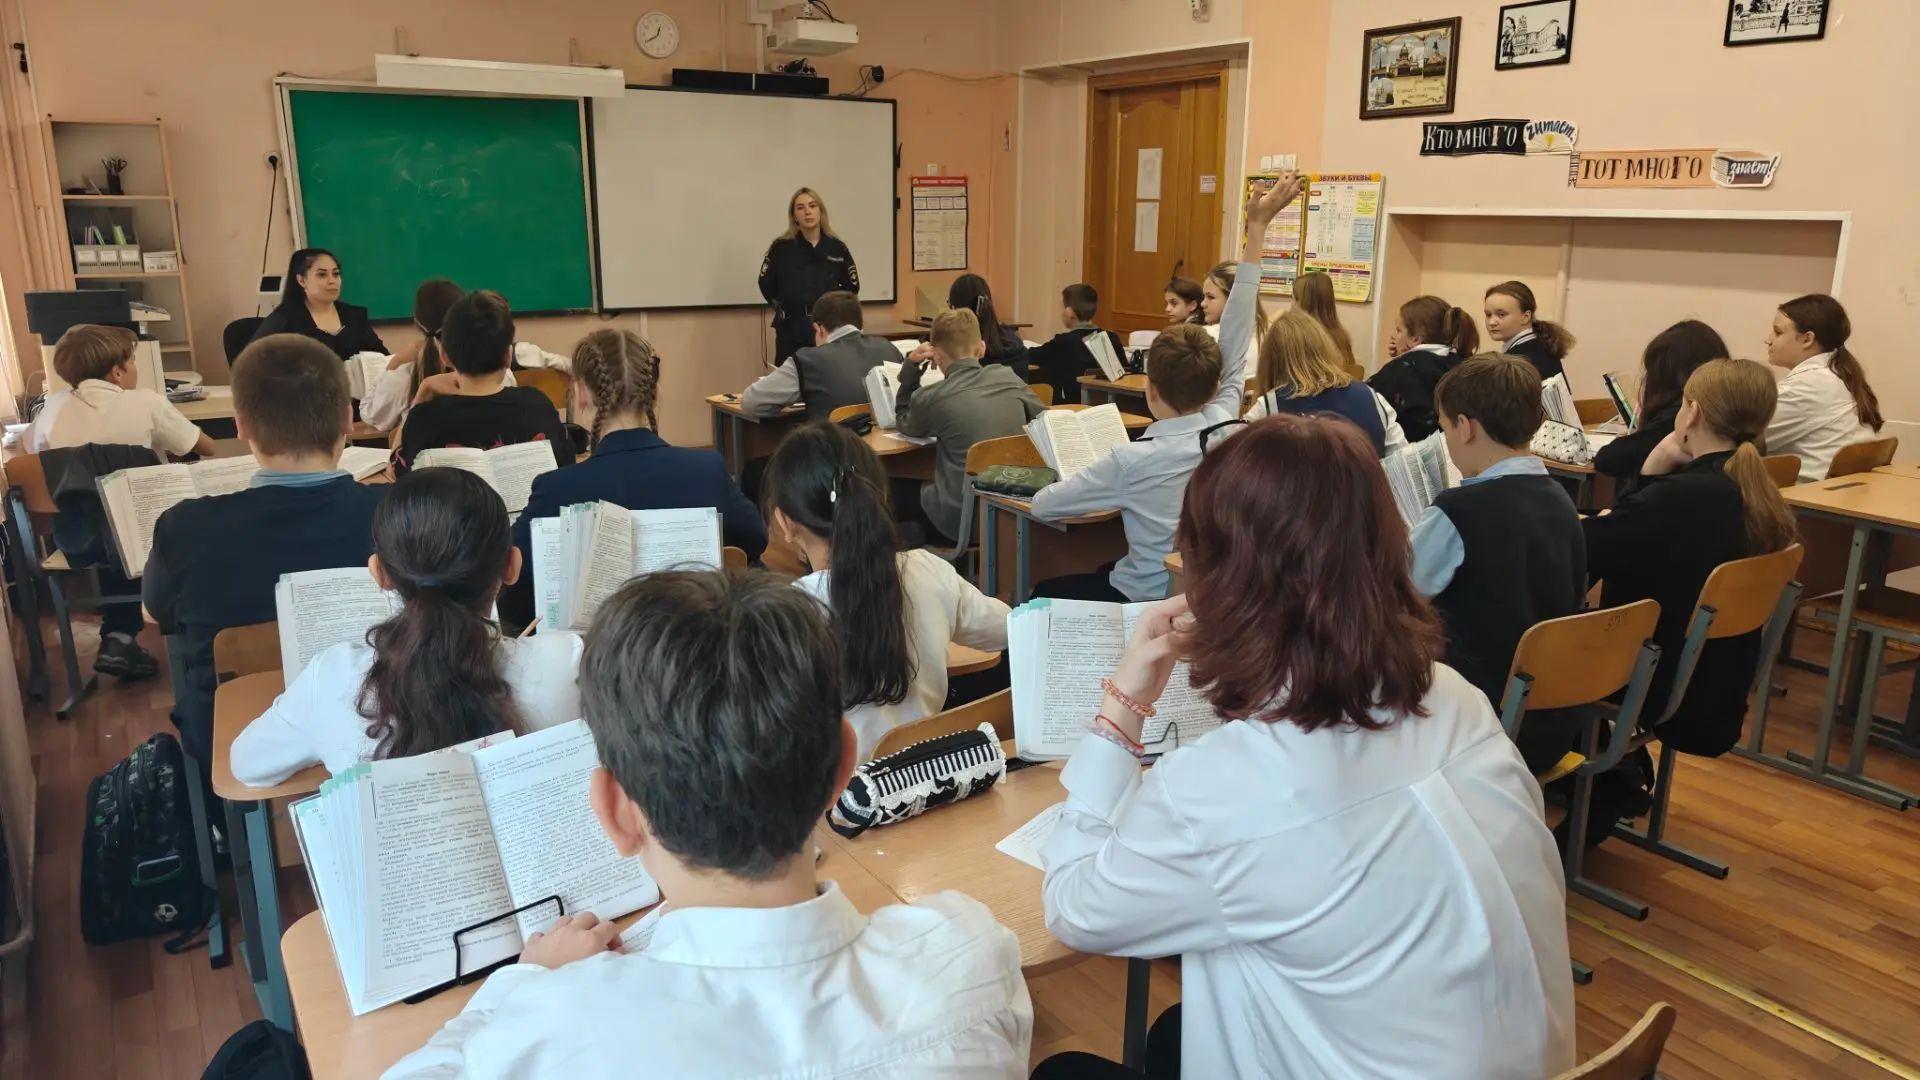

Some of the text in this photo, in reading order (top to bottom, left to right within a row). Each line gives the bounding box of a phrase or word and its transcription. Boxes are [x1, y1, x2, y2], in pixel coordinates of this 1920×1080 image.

[1456, 125, 1518, 148] МНОГО
[1581, 155, 1779, 184] ТОТ МНОГО знает!
